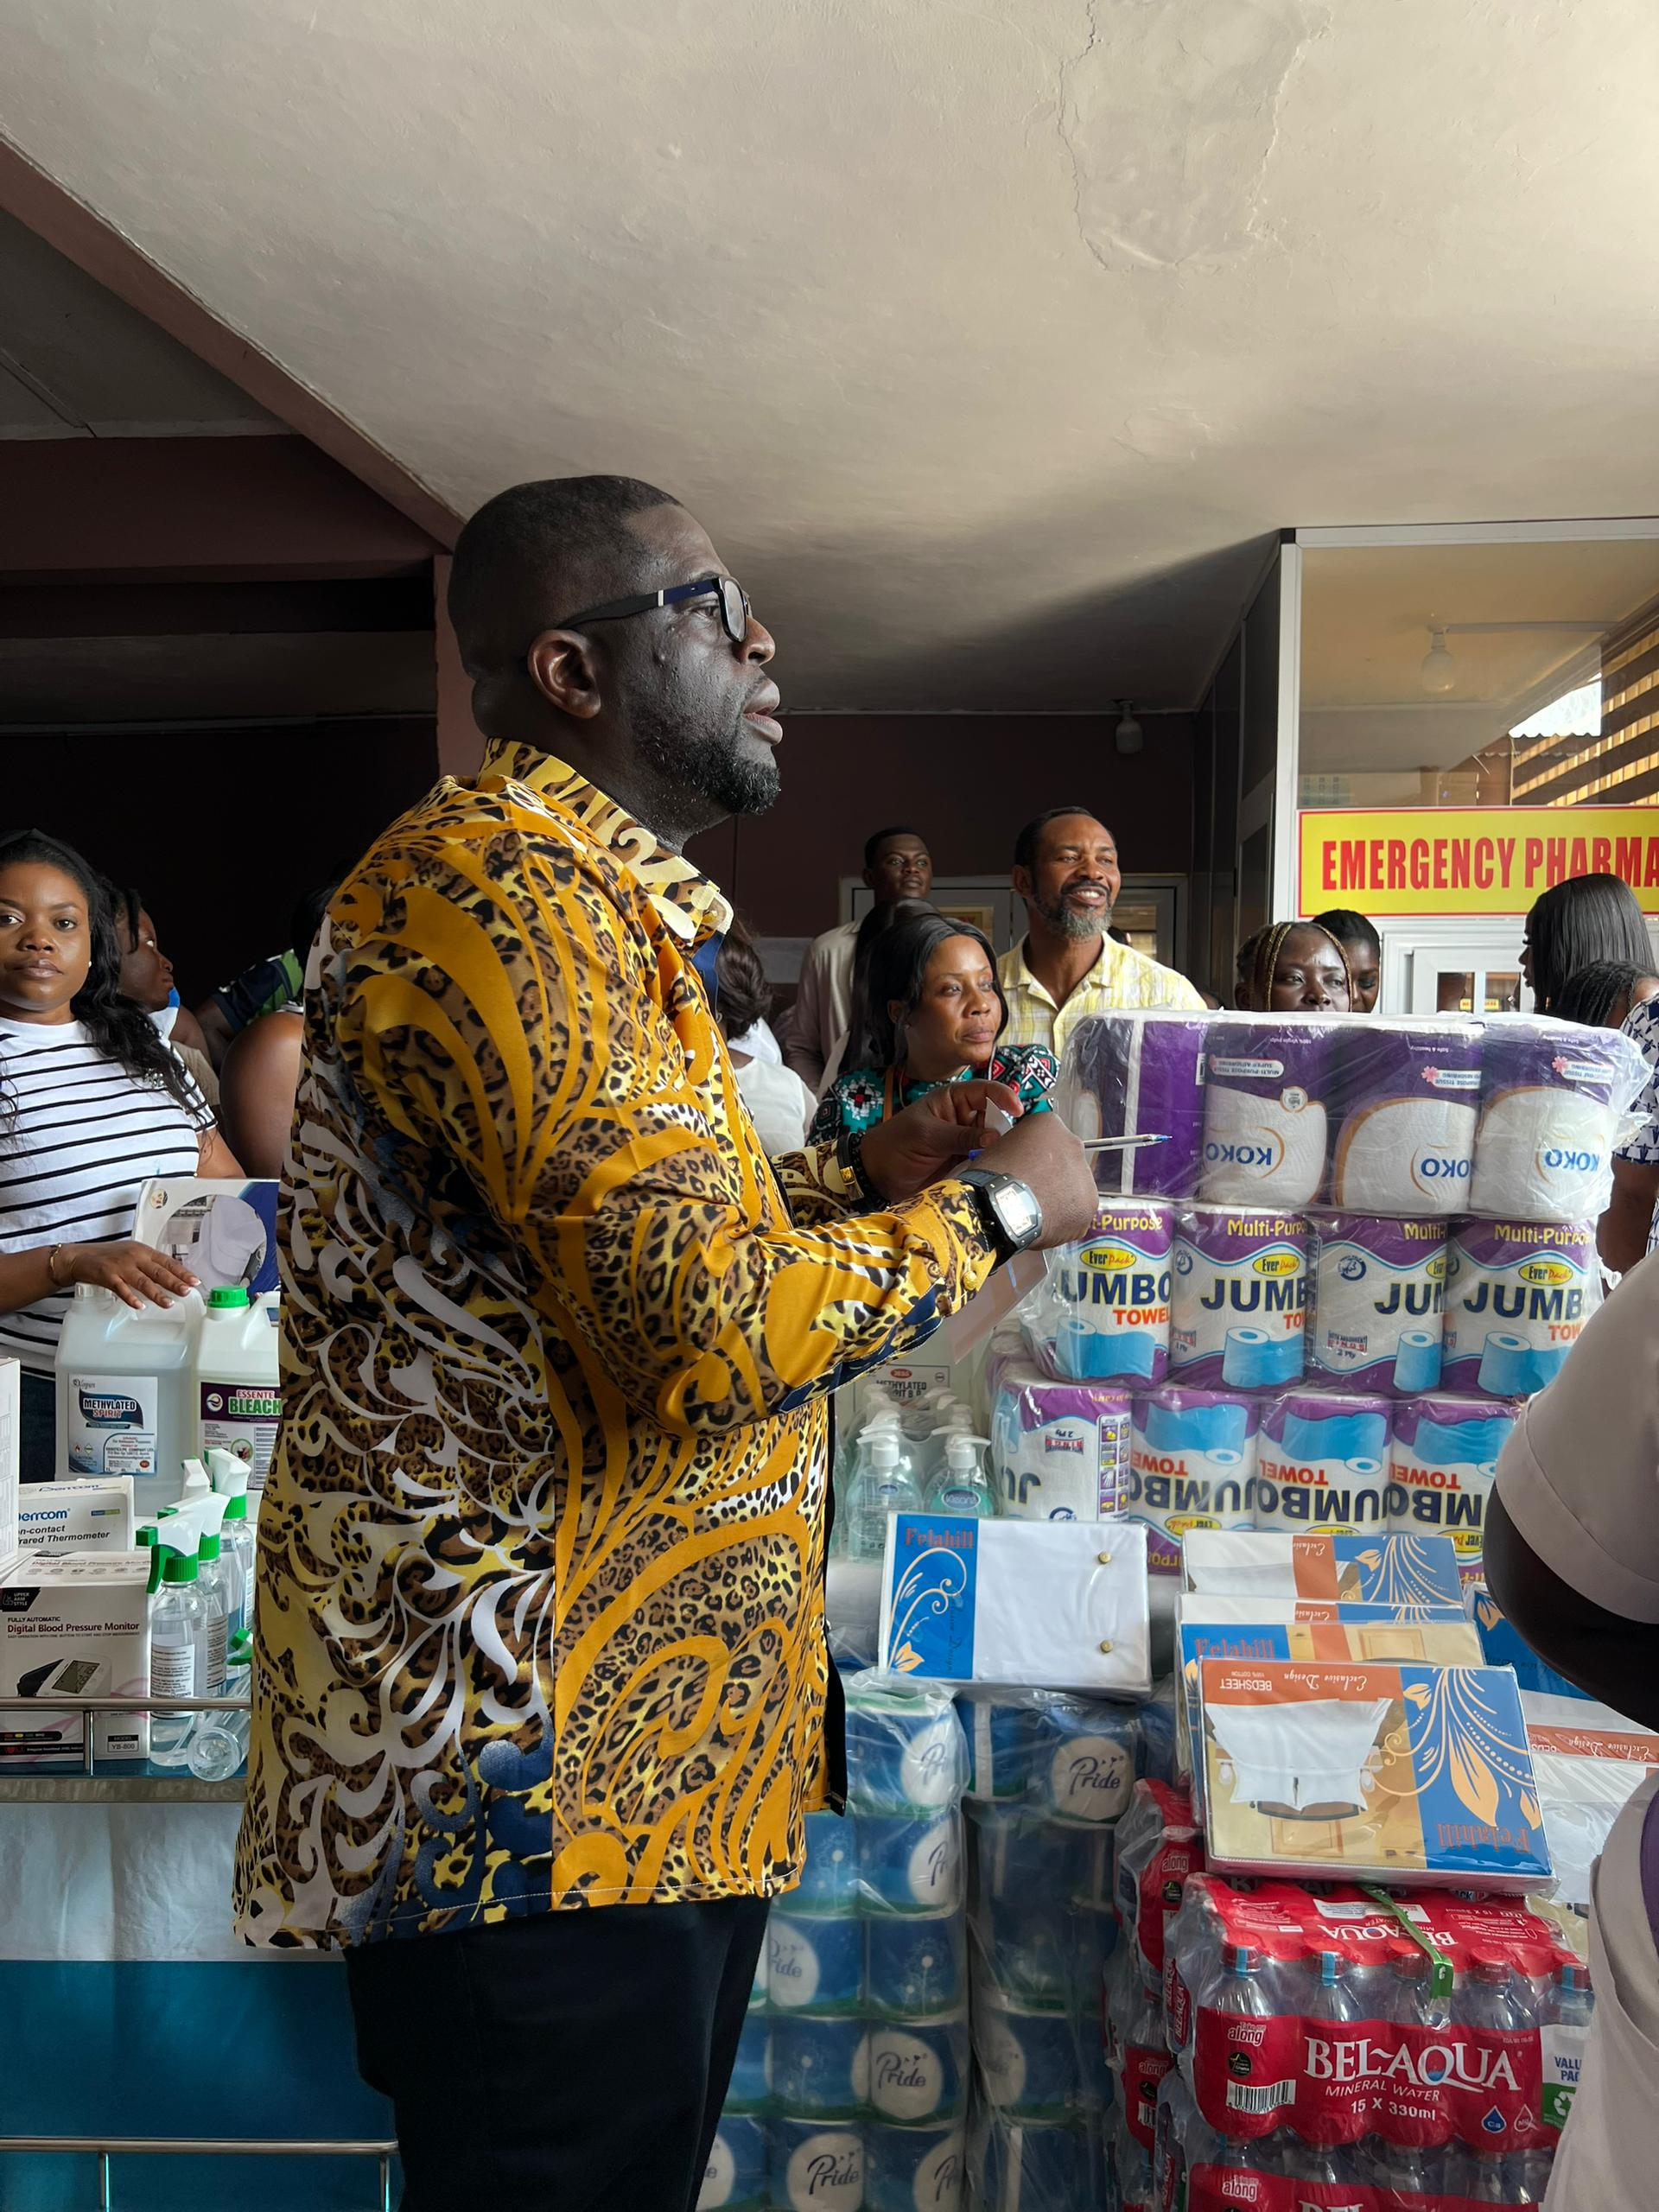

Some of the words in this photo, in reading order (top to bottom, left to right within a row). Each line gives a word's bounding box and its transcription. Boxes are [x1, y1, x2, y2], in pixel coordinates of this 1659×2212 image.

[1322, 837, 1516, 890] EMERGENCY
[1206, 1144, 1271, 1166] KOKO
[1421, 1158, 1470, 1178] OKO
[1090, 1251, 1108, 1265] Ever
[1262, 1259, 1279, 1272] Ever
[1528, 1266, 1548, 1279] Ever
[237, 1389, 275, 1398] ESSENTE
[83, 1399, 137, 1410] METHYLATED
[228, 1397, 281, 1414] BLEACH
[1259, 1459, 1329, 1485] TOWEL
[48, 1531, 110, 1542] Thermometer
[905, 1528, 974, 1548] Felahill
[8, 1624, 35, 1634] Digital
[105, 1622, 140, 1630] Monitor
[1219, 1678, 1272, 1692] BEDSHEET
[1284, 1669, 1319, 1690] Design
[1324, 1675, 1368, 1691] Exclusive
[1568, 1736, 1604, 1758] Design
[1607, 1743, 1649, 1762] Exclusive
[1069, 1756, 1121, 1796] Pride
[1438, 1823, 1529, 1853] Felahill
[1162, 1855, 1189, 1872] along
[1228, 2026, 1264, 2046] along
[875, 2051, 926, 2089] Pride
[1325, 2080, 1387, 2097] MINERAL
[1393, 2083, 1440, 2101] WATER
[1351, 2098, 1366, 2114] 15
[1389, 2101, 1436, 2120] 330ml
[807, 2154, 860, 2195] Pride
[1222, 2181, 1258, 2202] along
